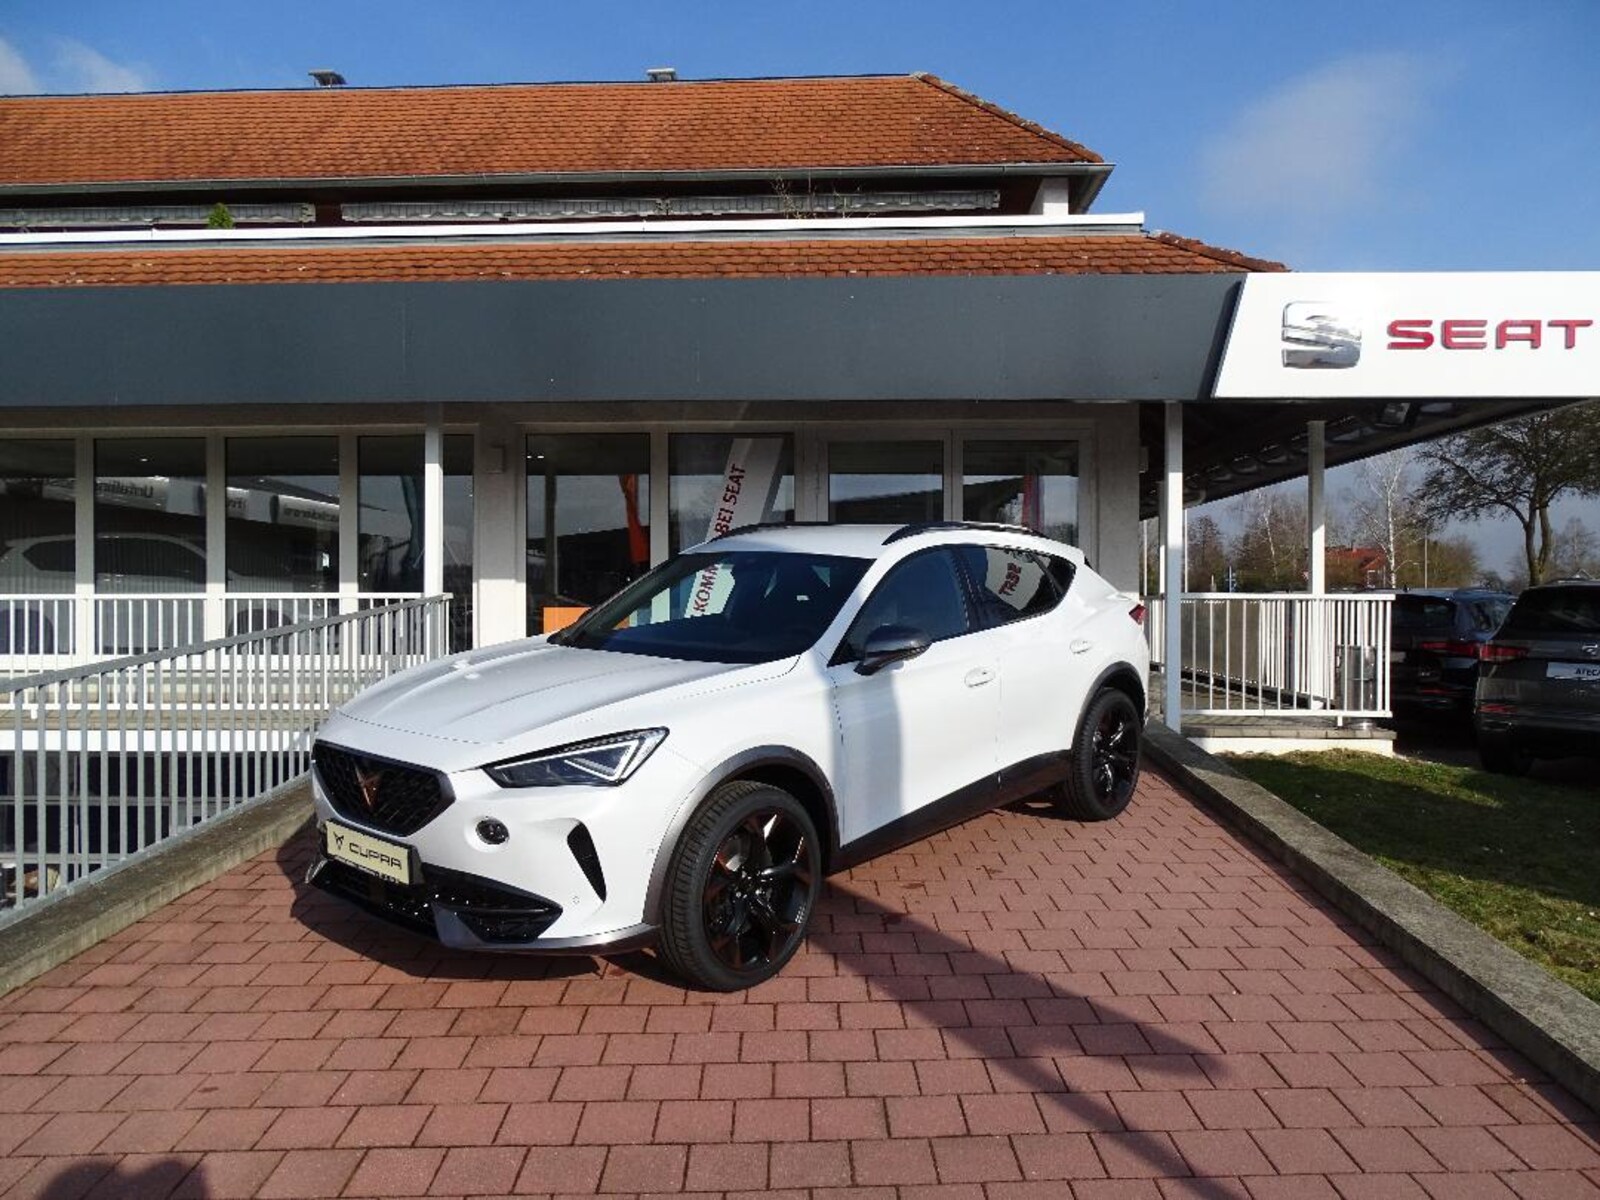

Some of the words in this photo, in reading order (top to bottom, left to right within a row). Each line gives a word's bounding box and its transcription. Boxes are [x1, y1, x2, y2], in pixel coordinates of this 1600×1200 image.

[1387, 319, 1593, 350] SEAT
[722, 463, 746, 505] SEAT
[714, 507, 734, 535] BEI
[349, 842, 402, 870] CUPRA
